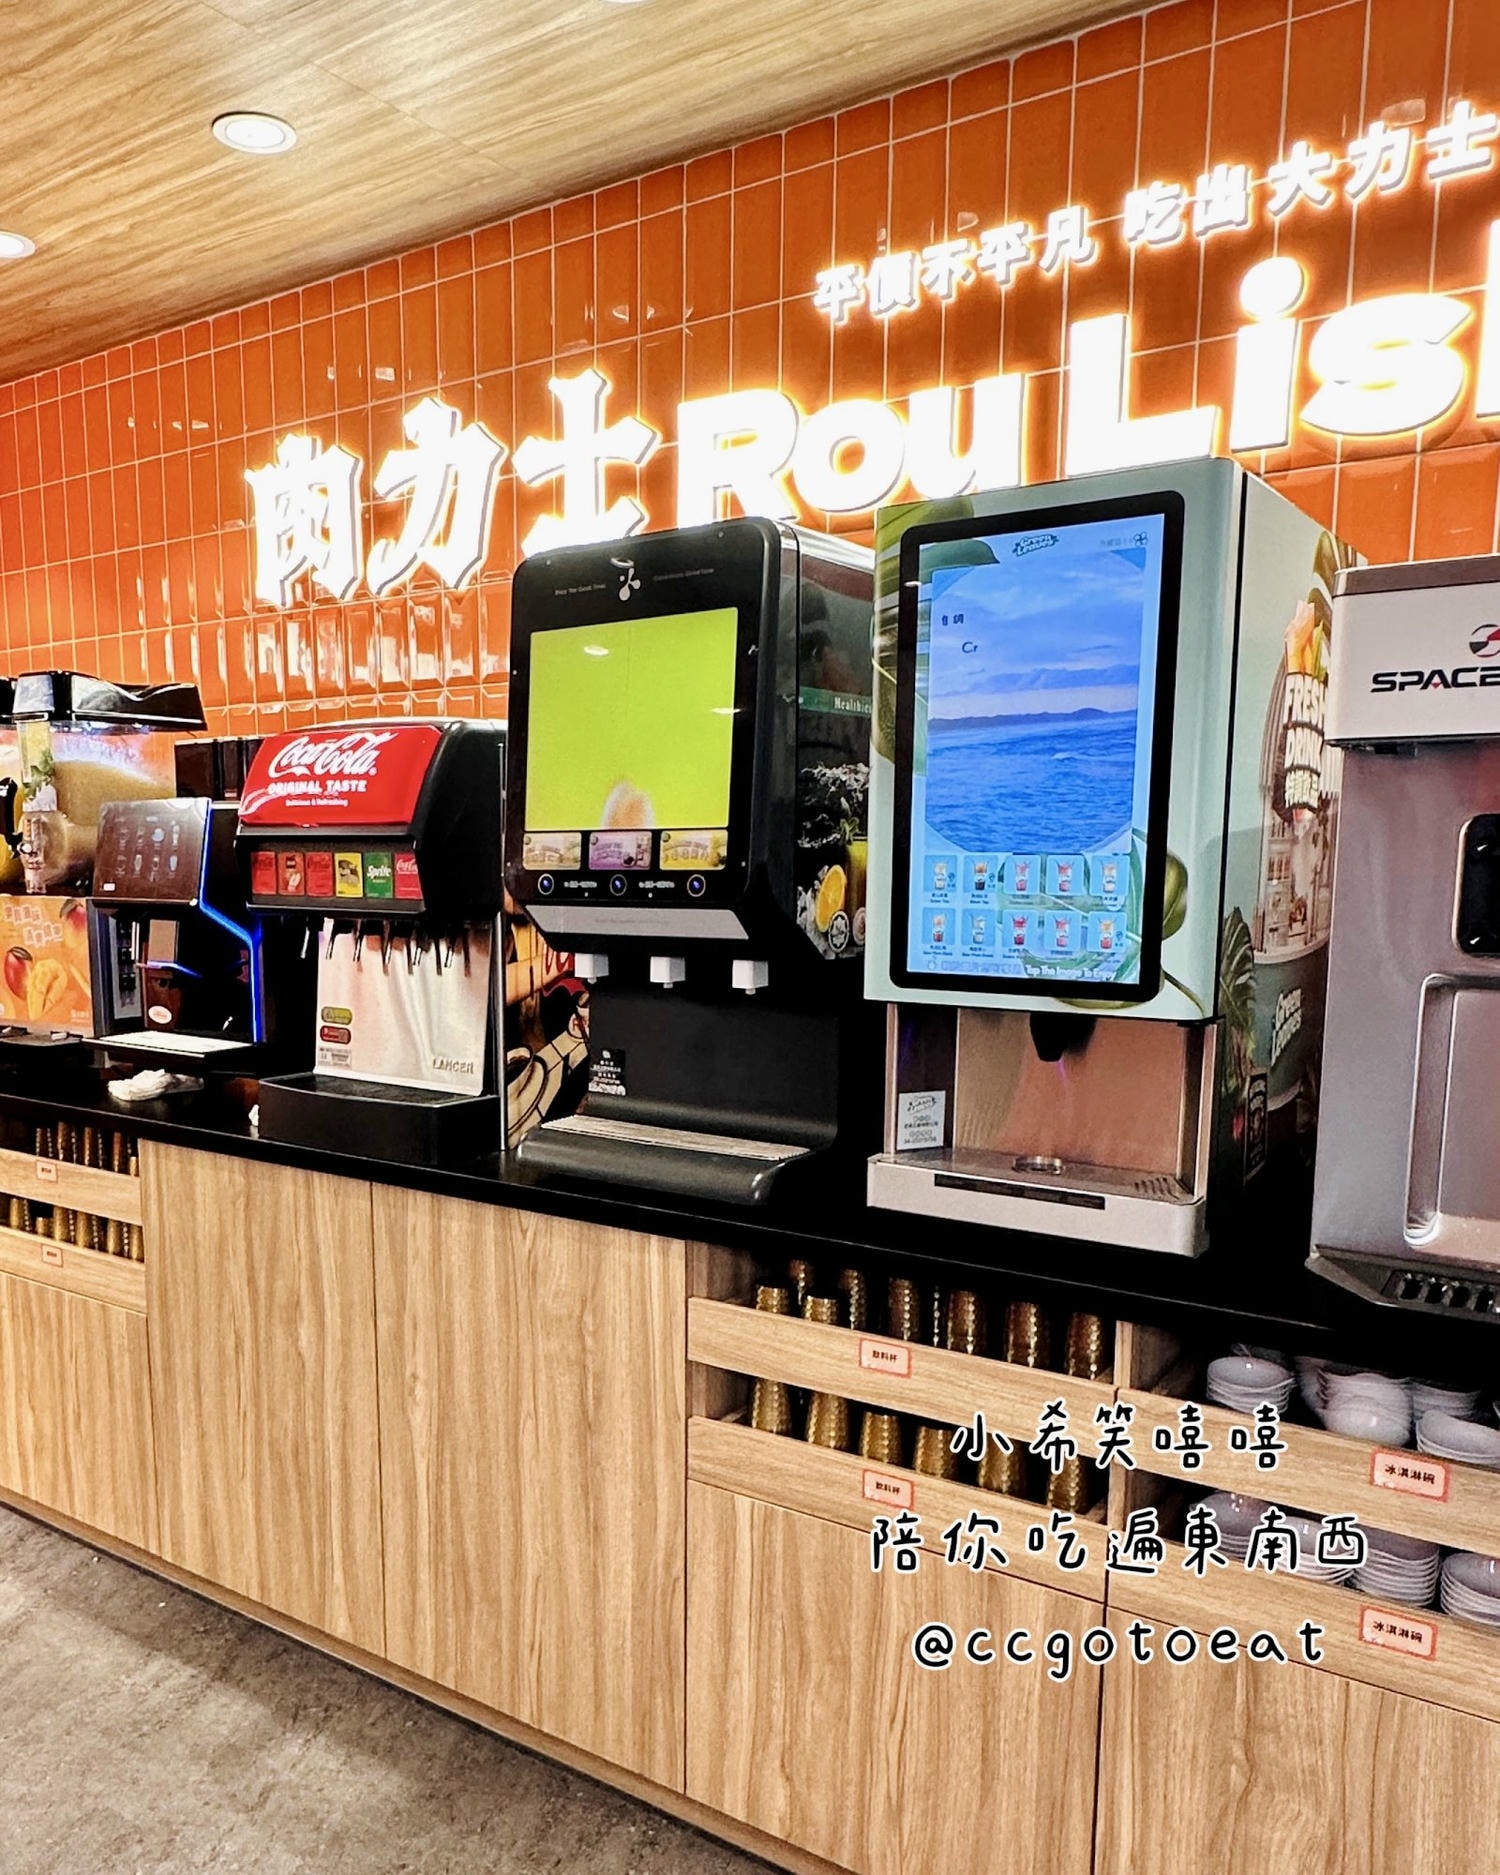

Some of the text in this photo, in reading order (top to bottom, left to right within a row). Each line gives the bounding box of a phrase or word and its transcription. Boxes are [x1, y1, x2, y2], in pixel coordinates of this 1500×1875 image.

[813, 99, 1499, 322] 平價不平凡 吃出大力士
[1066, 217, 1500, 478] Lis
[244, 368, 659, 608] 肉力士
[268, 731, 400, 779] Coca-Cola
[267, 779, 368, 796] ORIGINAL TASTE
[366, 864, 392, 879] Sprite
[431, 1057, 475, 1075] LANCER
[1384, 1464, 1436, 1485] 冰淇淋碗
[1372, 1620, 1423, 1643] 冰淇淋碗
